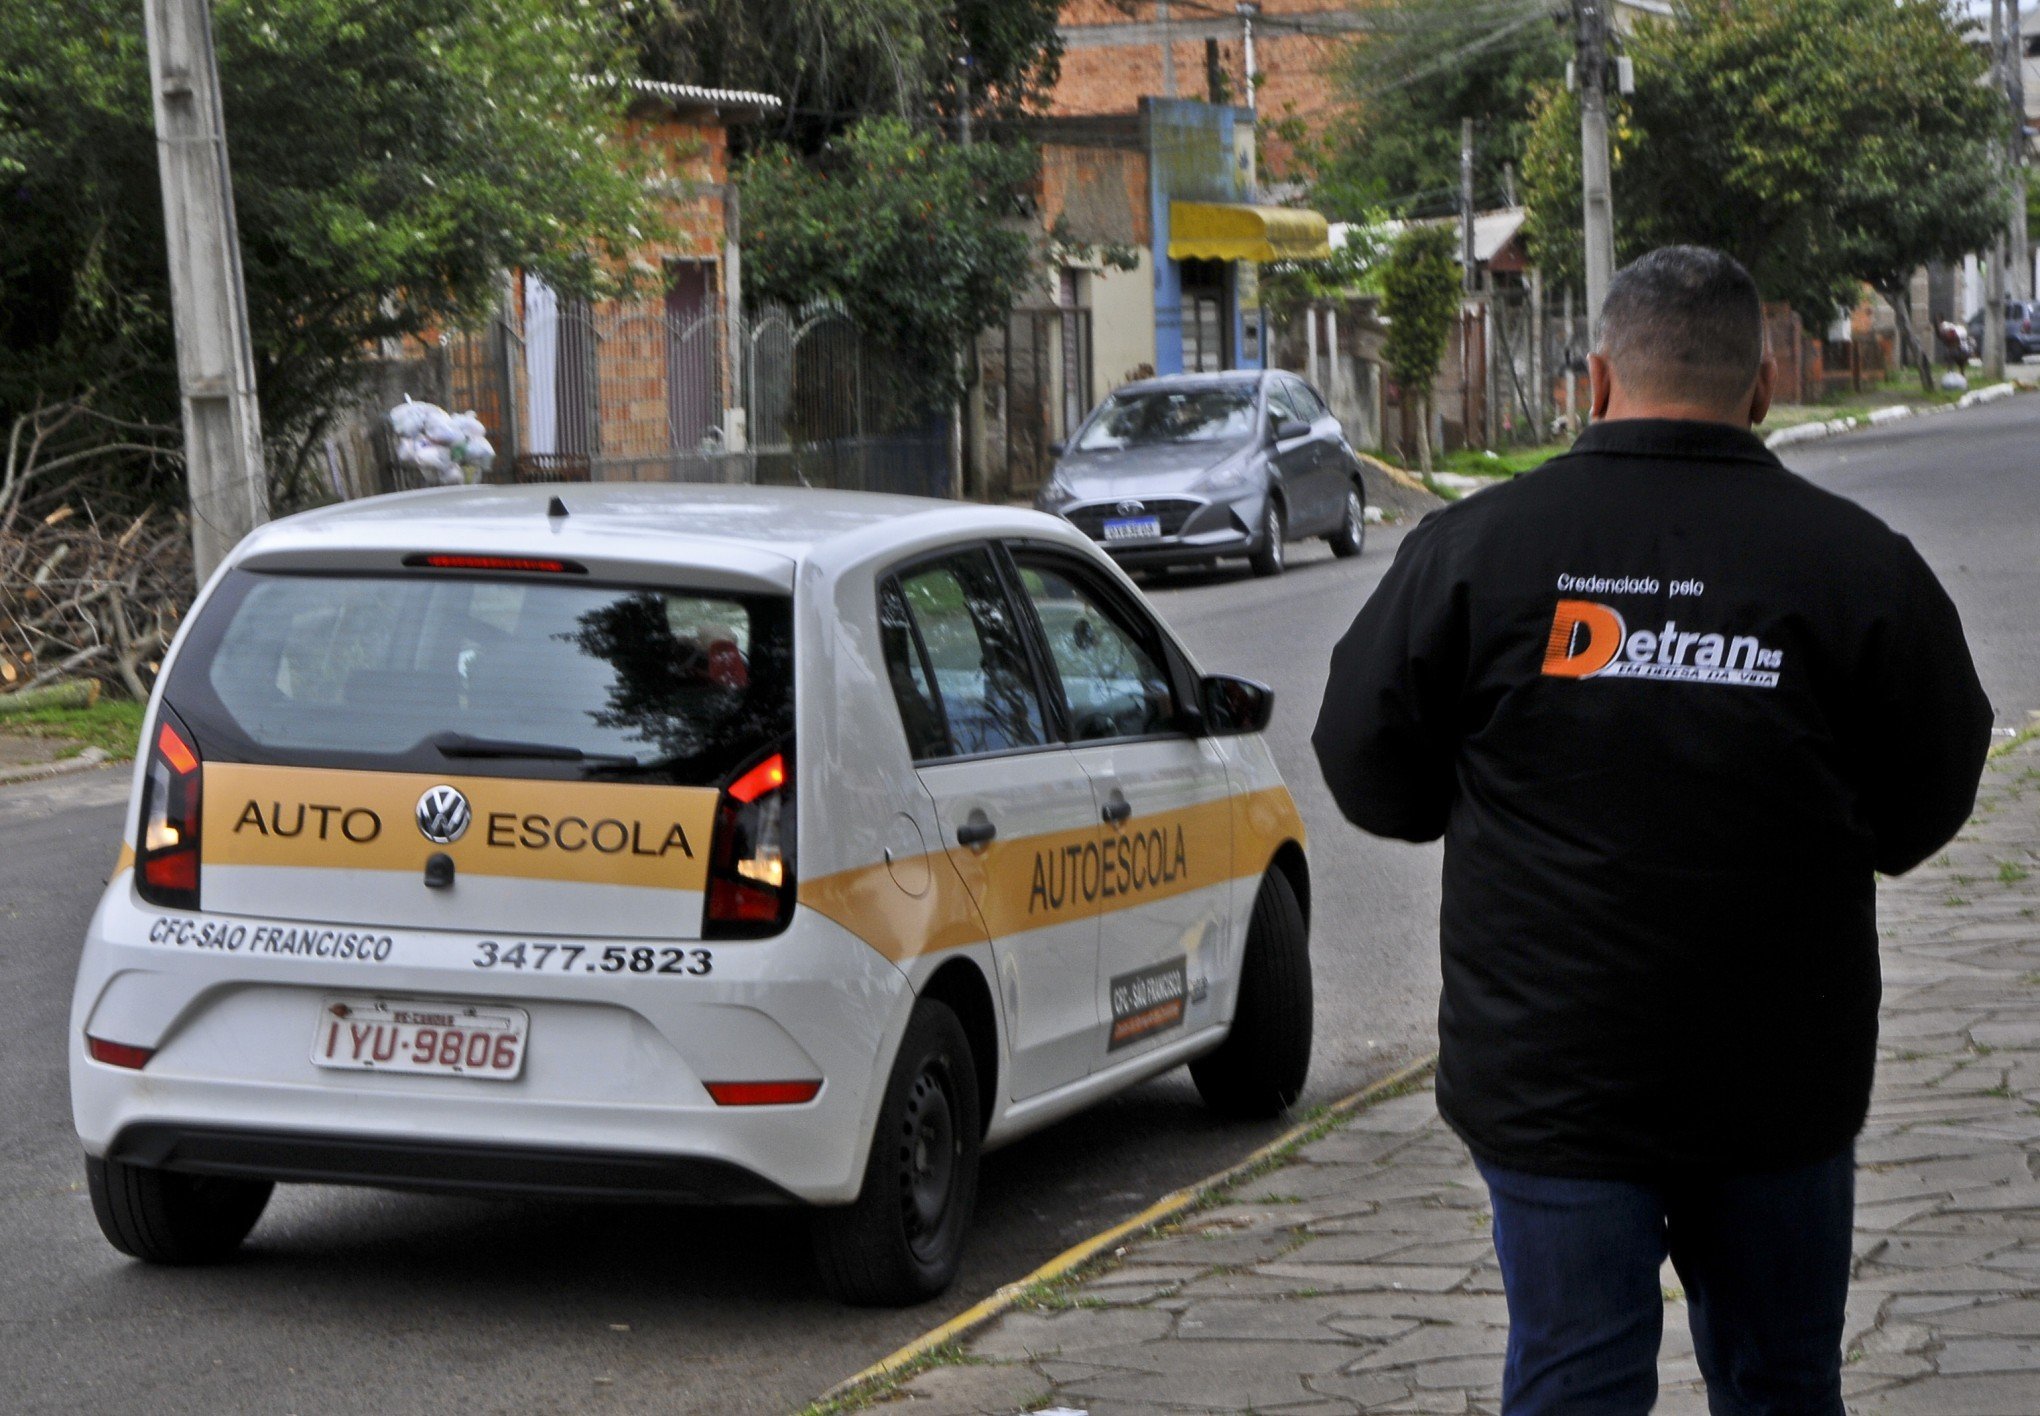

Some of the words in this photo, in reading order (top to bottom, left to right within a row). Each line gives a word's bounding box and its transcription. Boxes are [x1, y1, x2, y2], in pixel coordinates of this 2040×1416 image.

[1556, 572, 1660, 594] Credenciado
[1669, 577, 1704, 598] pelo
[1541, 598, 1759, 680] Detran
[1757, 648, 1783, 669] RS
[233, 799, 382, 843] AUTO
[486, 812, 695, 860] ESCOLA
[1028, 822, 1188, 916] AUTOESCOLA
[250, 926, 393, 962] FRANCISCO
[472, 940, 713, 976] 3477.5823
